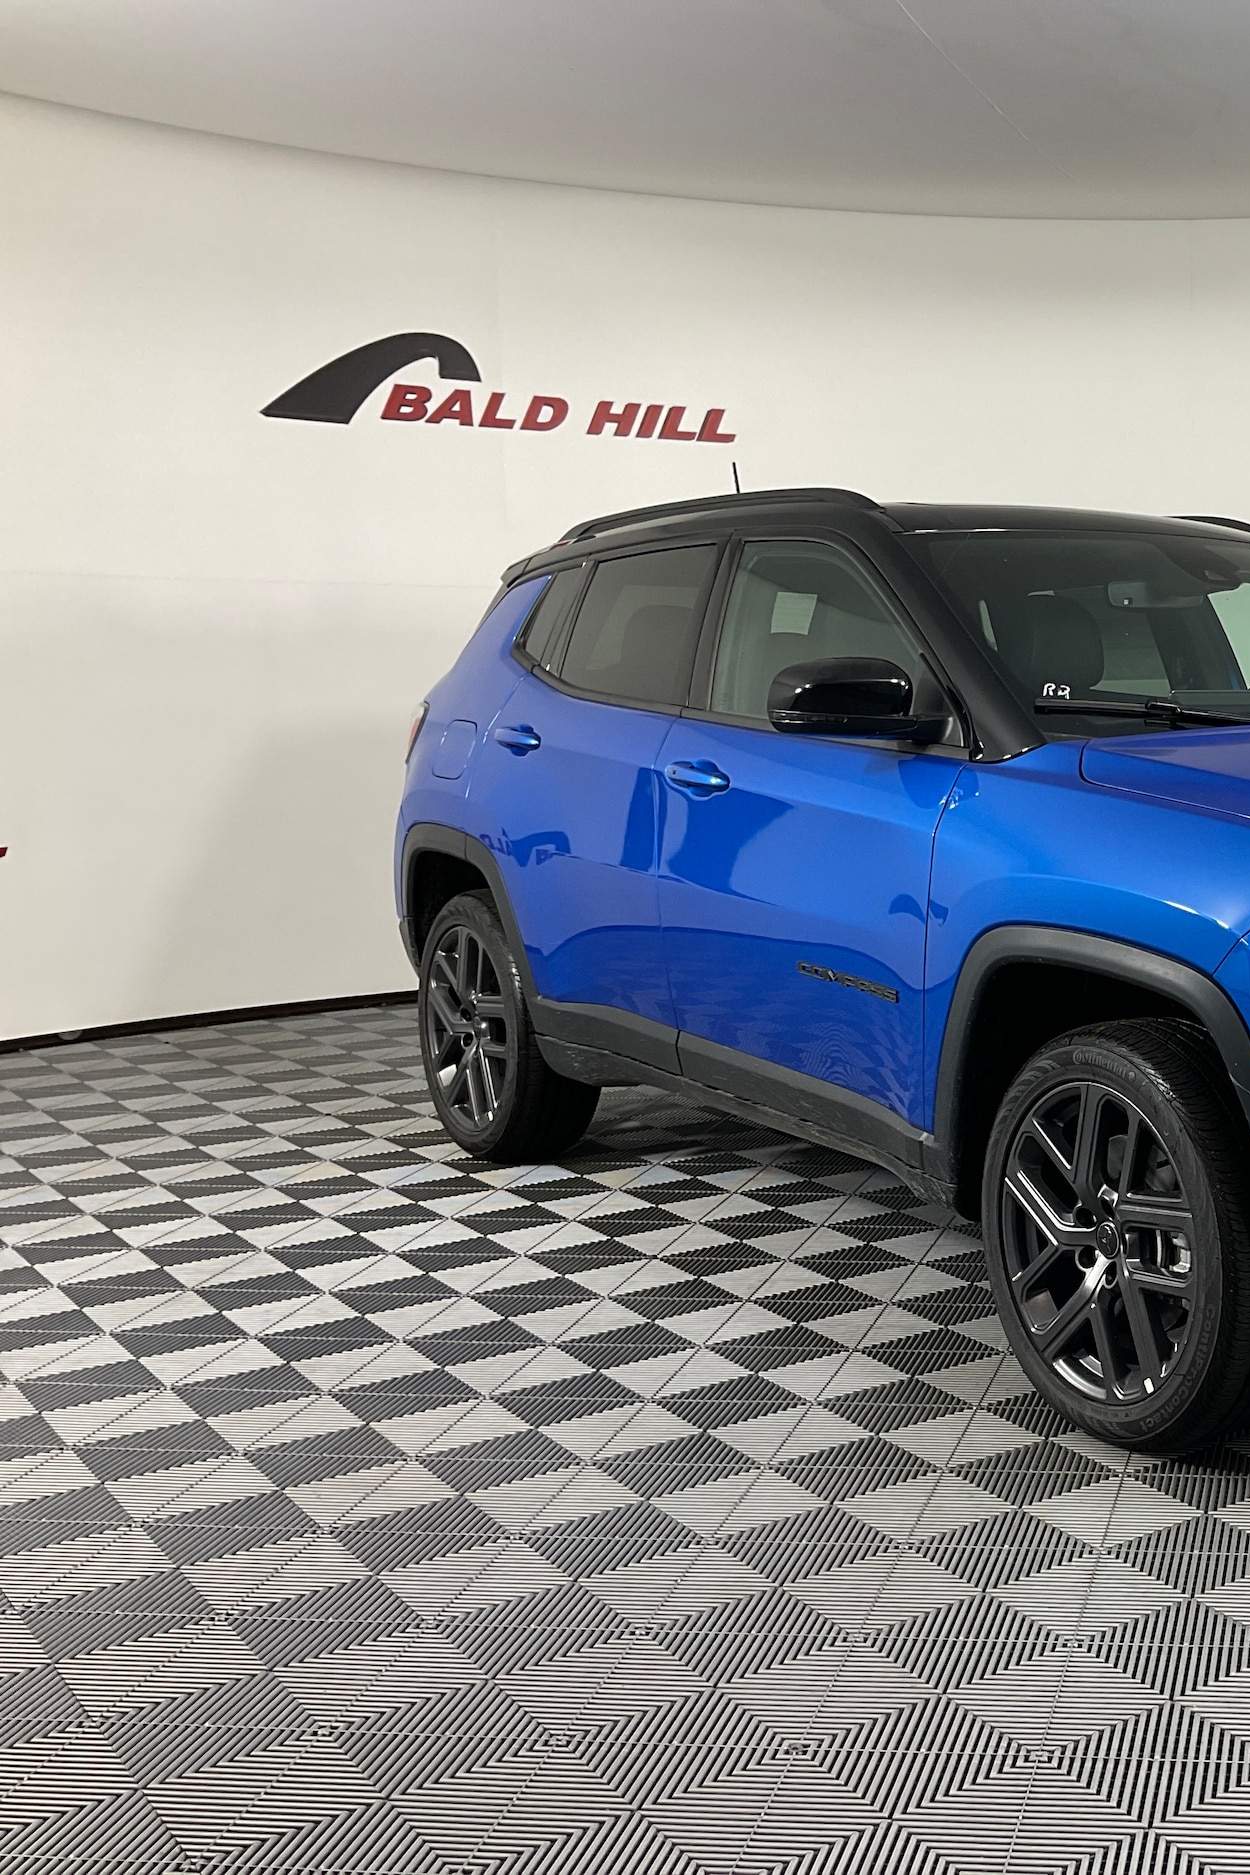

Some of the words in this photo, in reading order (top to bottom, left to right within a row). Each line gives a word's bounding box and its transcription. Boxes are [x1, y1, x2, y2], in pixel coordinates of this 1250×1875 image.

[381, 384, 569, 431] BALD
[586, 401, 737, 443] HILL
[798, 961, 899, 1003] COMPASS
